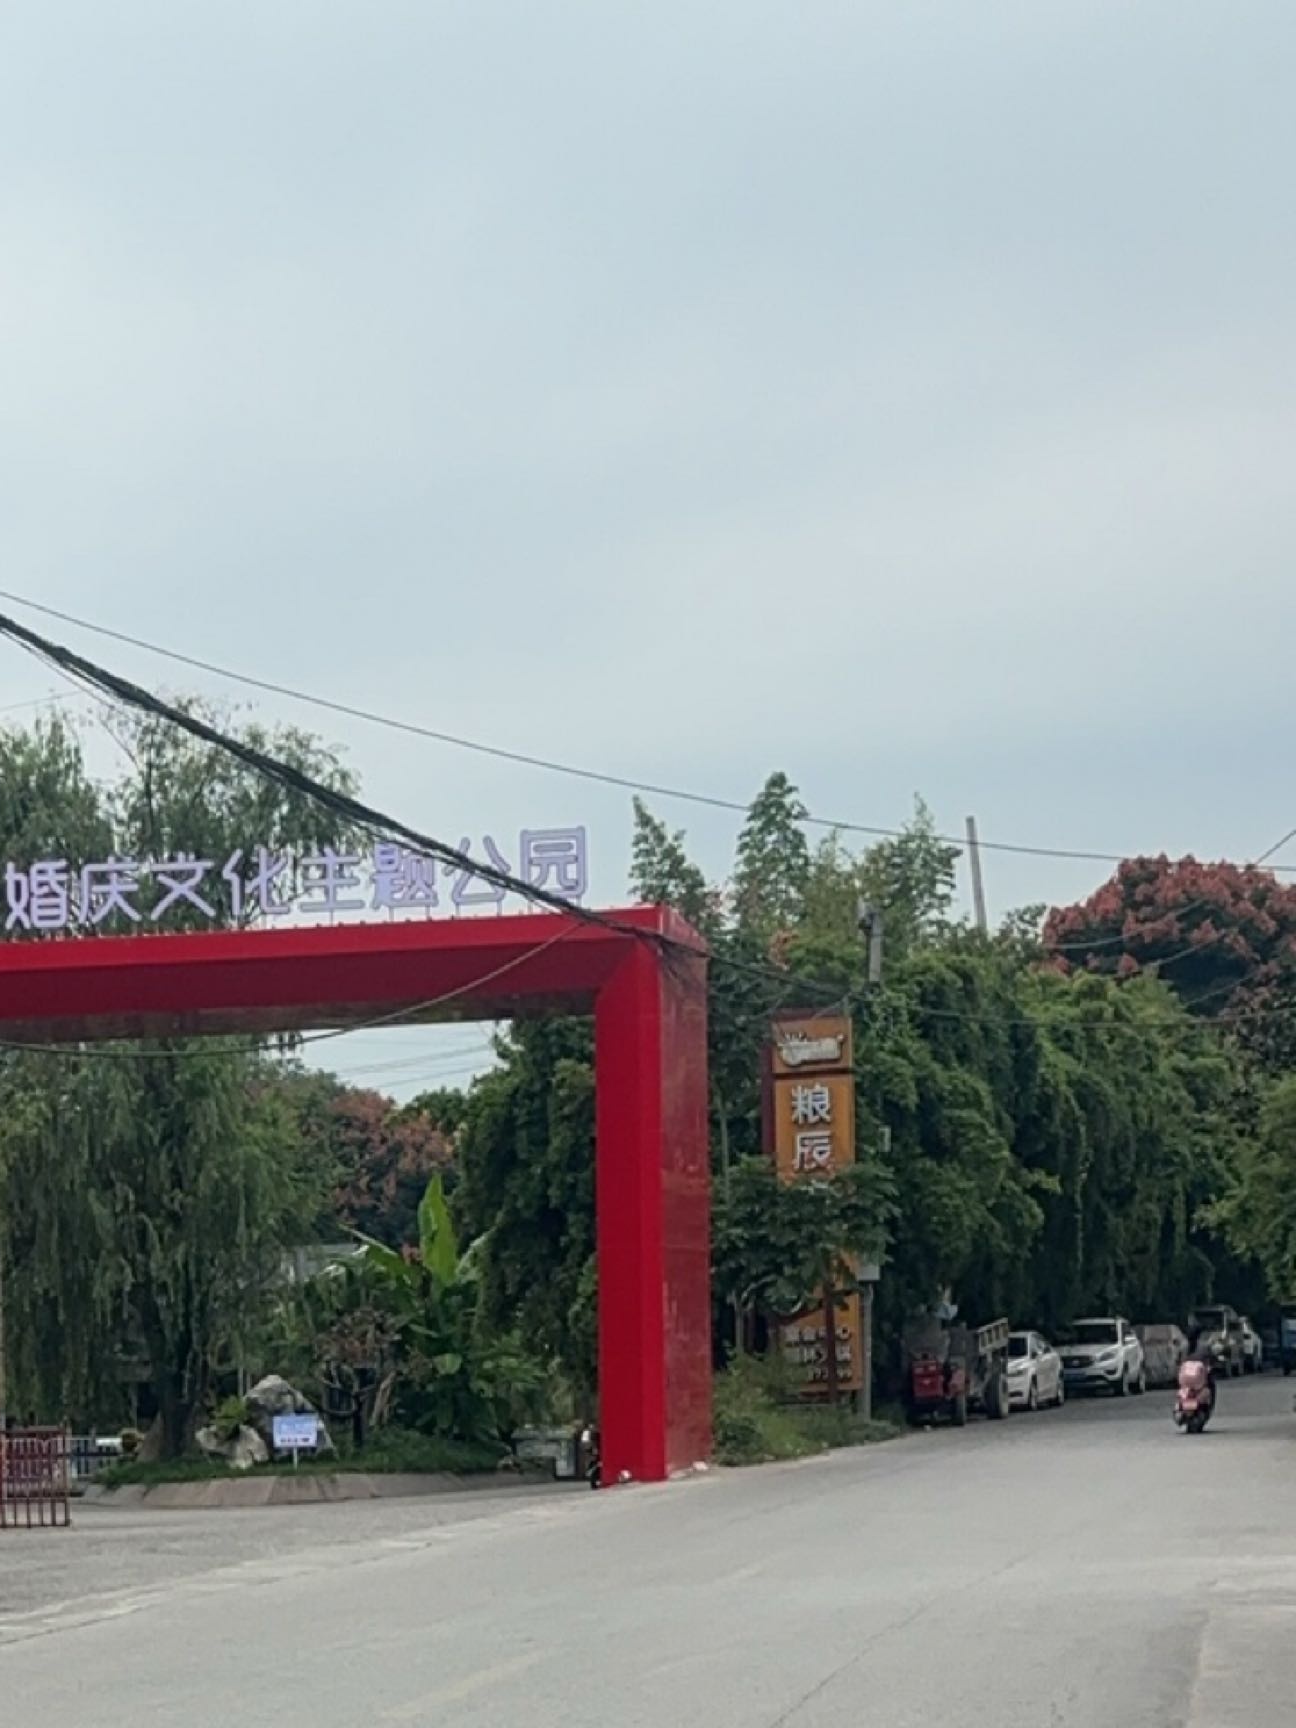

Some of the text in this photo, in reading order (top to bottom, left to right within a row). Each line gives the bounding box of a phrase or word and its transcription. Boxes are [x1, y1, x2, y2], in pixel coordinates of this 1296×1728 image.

[4, 826, 587, 928] 婚庆文化主题公园
